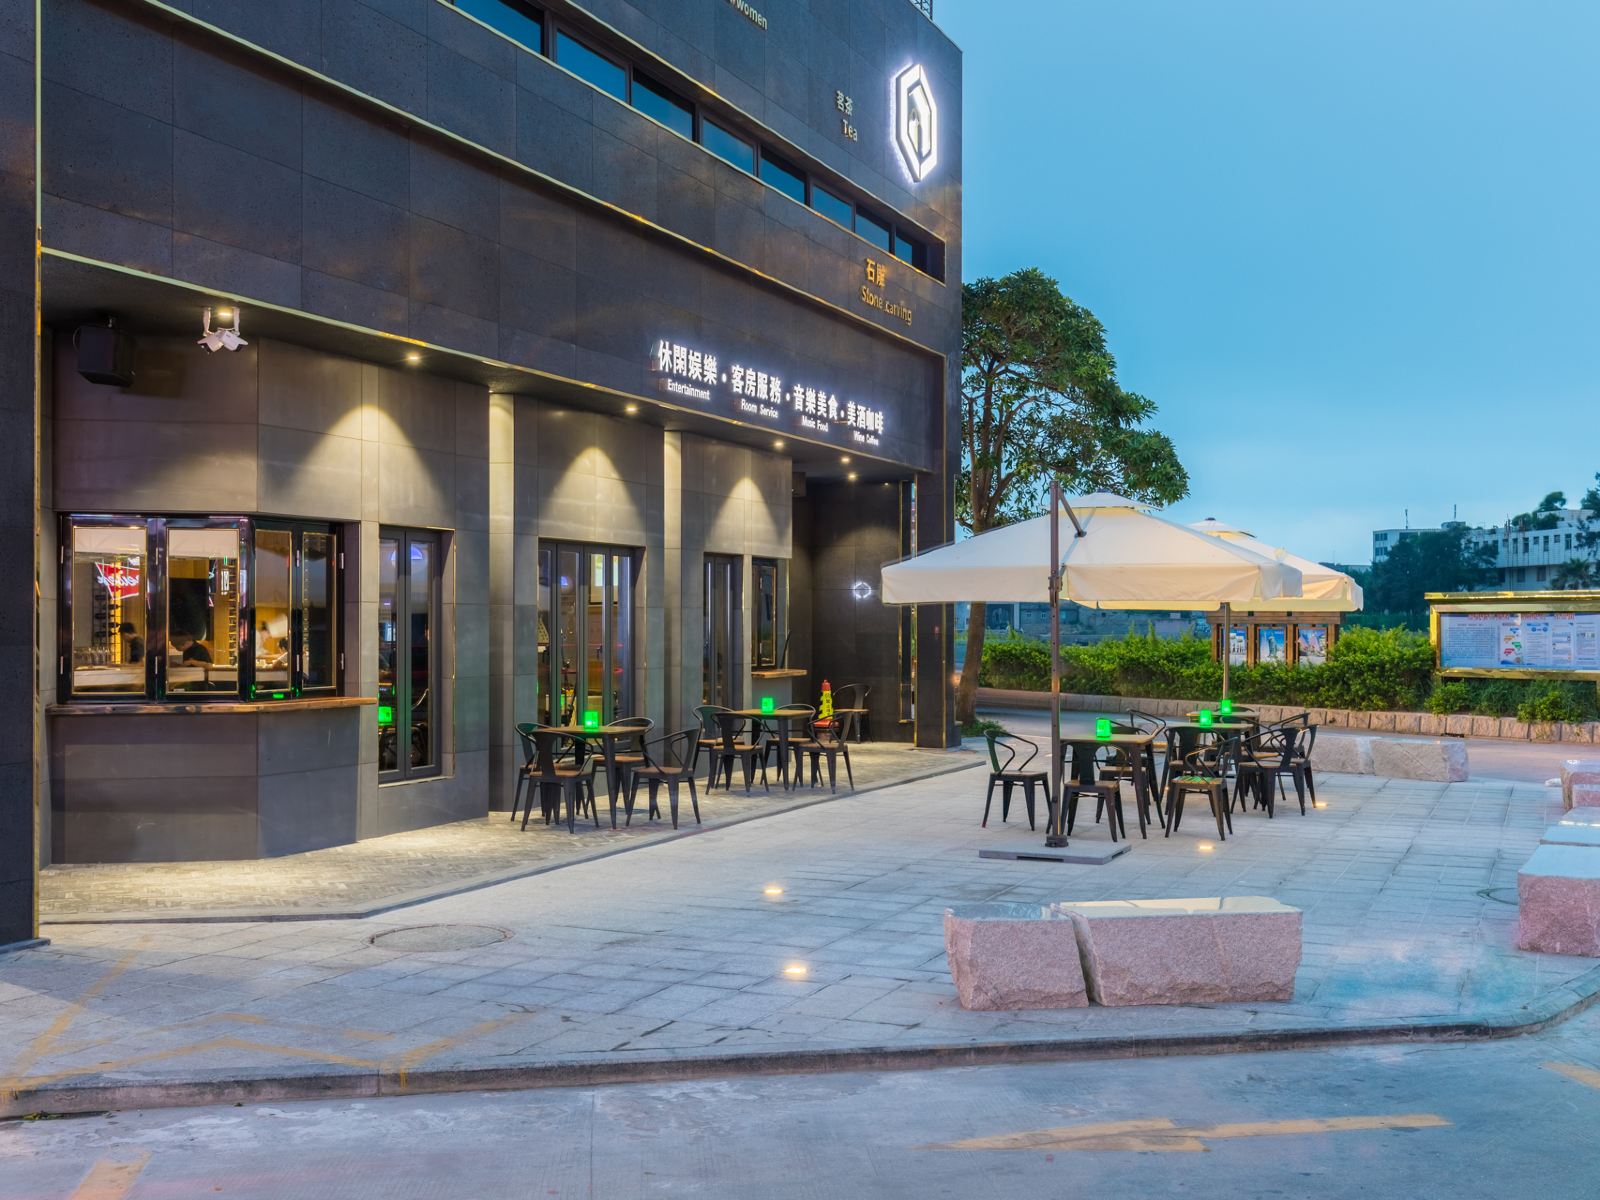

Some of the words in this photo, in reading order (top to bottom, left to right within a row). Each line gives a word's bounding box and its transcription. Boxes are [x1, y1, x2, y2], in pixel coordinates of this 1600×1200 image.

[843, 119, 858, 142] Tea
[861, 285, 883, 309] Stone
[885, 301, 912, 326] carving
[667, 378, 711, 401] Entertainment
[741, 398, 758, 413] Room
[760, 403, 779, 419] Service
[801, 415, 816, 428] Music
[817, 420, 829, 432] Food
